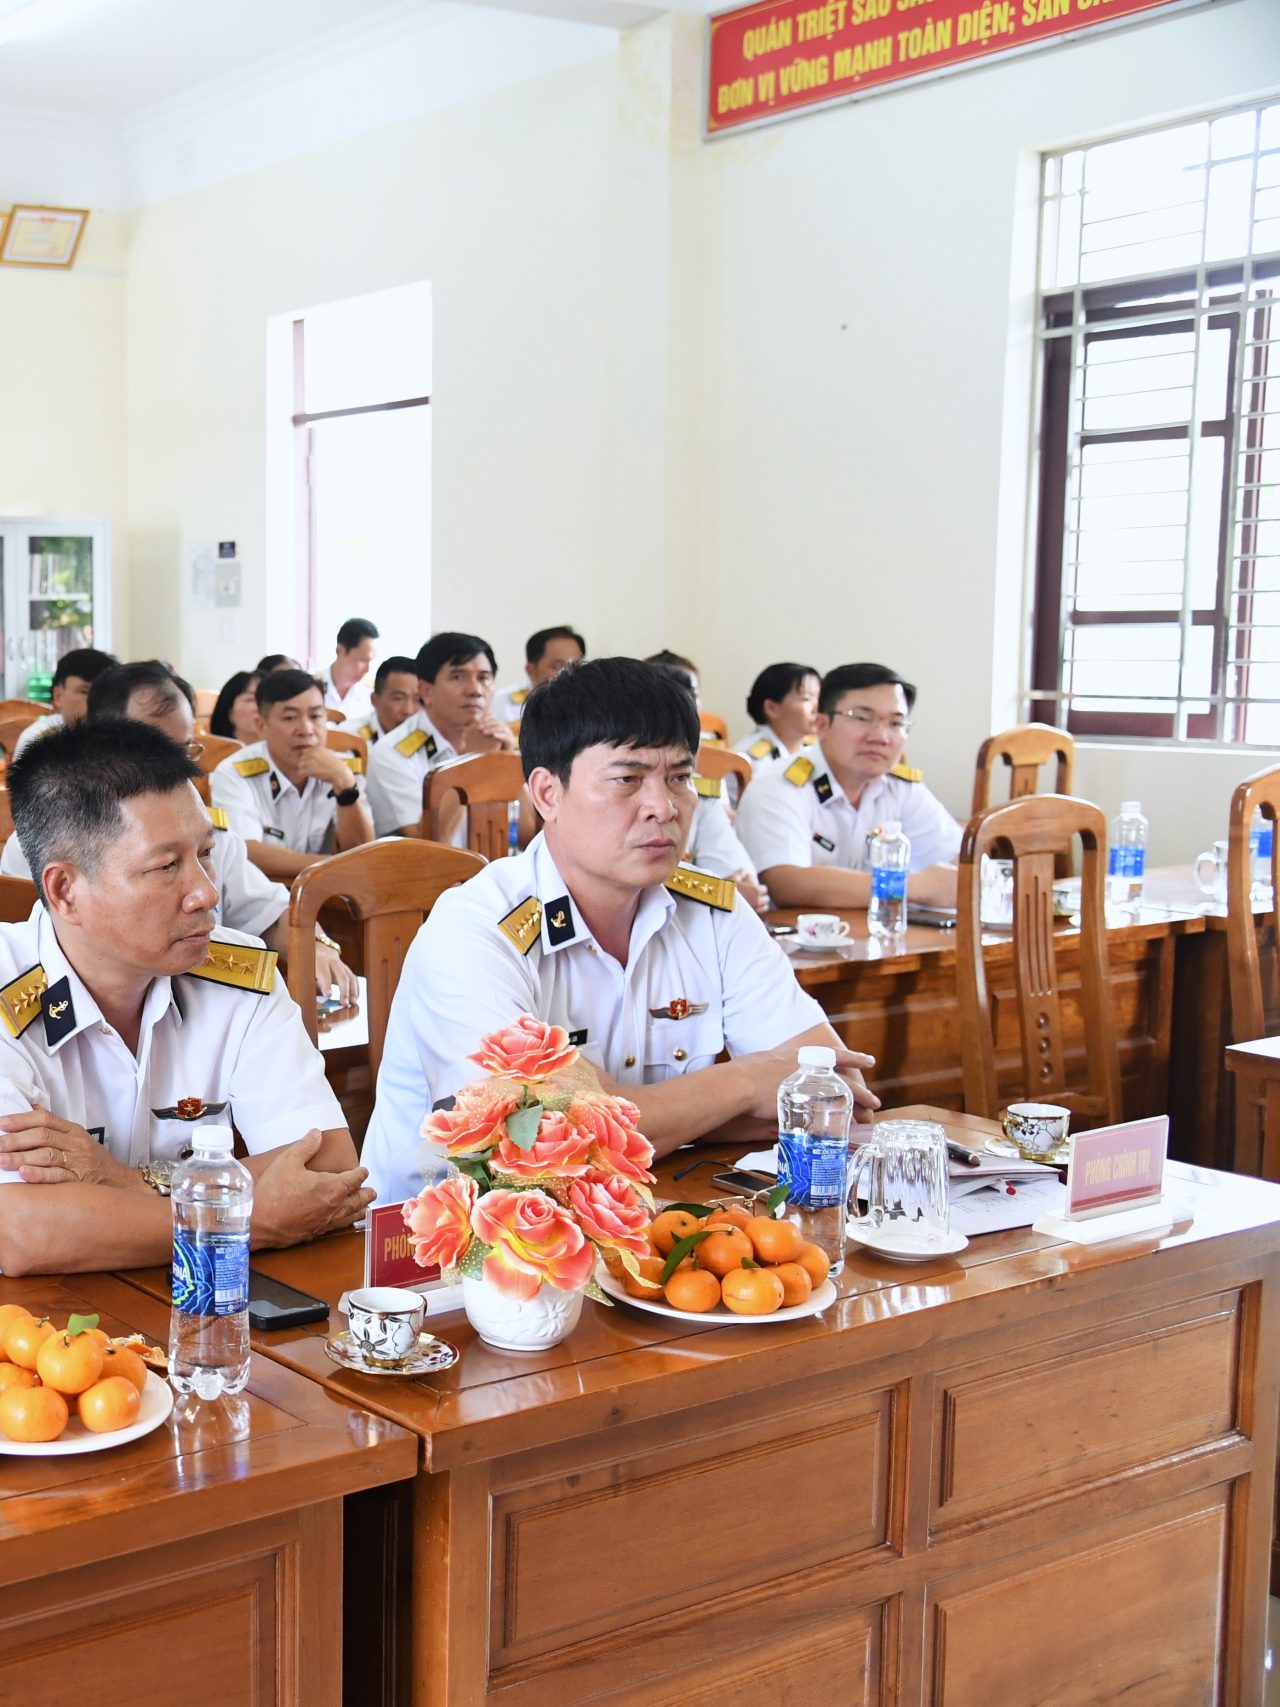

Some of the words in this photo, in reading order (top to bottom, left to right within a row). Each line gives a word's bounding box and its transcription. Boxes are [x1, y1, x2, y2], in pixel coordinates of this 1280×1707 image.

[742, 16, 794, 61] QUÁN
[796, 0, 848, 43] TRIỆT
[758, 70, 776, 107] VỊ
[832, 35, 893, 82] MẠNH
[897, 17, 953, 63] TOÀN
[956, 0, 1016, 46] DIỆN;
[383, 1228, 417, 1262] PHÒN
